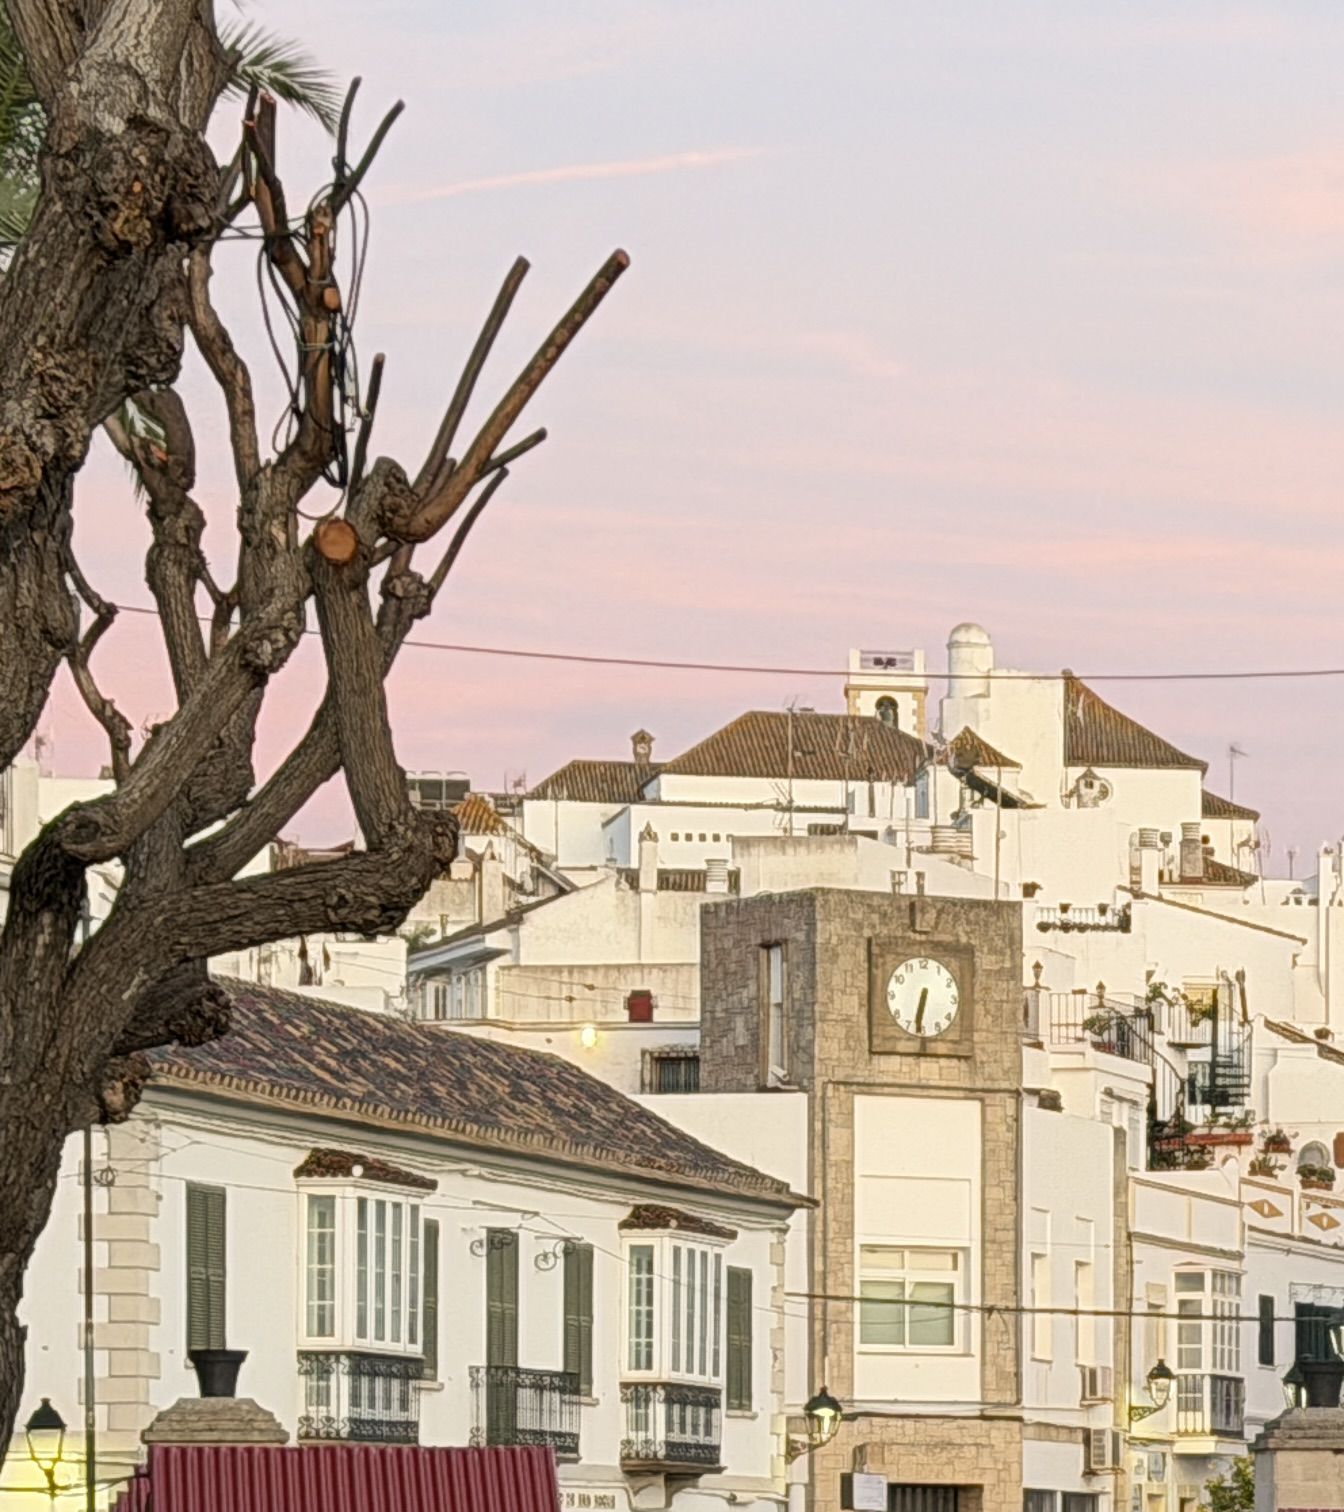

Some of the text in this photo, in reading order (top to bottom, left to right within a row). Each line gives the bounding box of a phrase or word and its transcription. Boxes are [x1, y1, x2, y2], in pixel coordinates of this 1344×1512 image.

[904, 963, 914, 973] 11
[919, 959, 929, 970] 12
[936, 965, 941, 976] 1
[894, 974, 905, 985] 10
[945, 977, 953, 988] 2
[905, 1020, 912, 1030] 7
